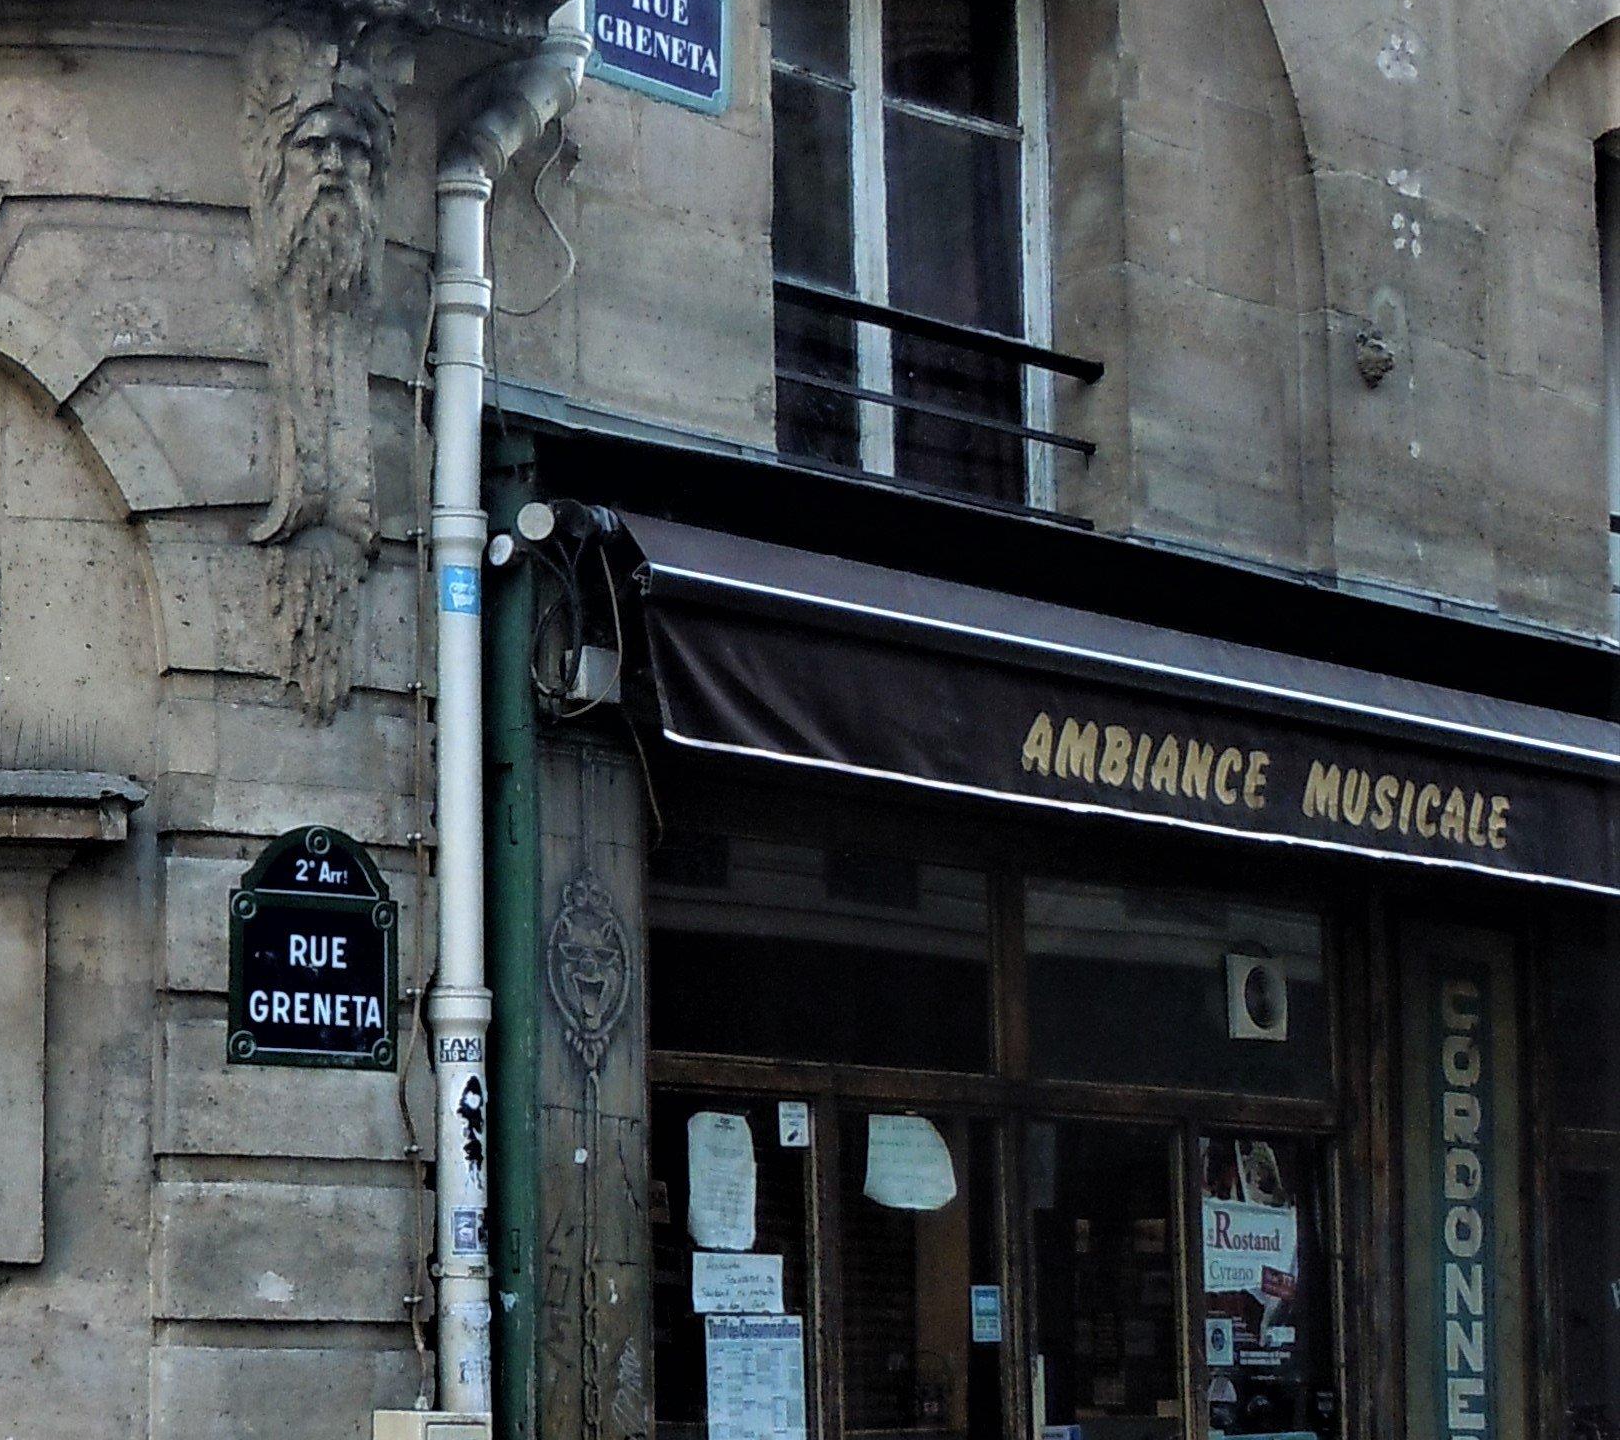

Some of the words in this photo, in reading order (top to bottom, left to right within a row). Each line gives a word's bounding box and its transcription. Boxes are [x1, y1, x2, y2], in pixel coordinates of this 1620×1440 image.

[597, 14, 718, 78] GRENETA
[1021, 712, 1271, 809] AMBIANCE
[1302, 758, 1512, 851] MUSICALE
[287, 934, 347, 970] RUE
[248, 989, 382, 1030] GRENETA
[1213, 1210, 1281, 1252] Rostand
[1209, 1260, 1254, 1281] Cyrano
